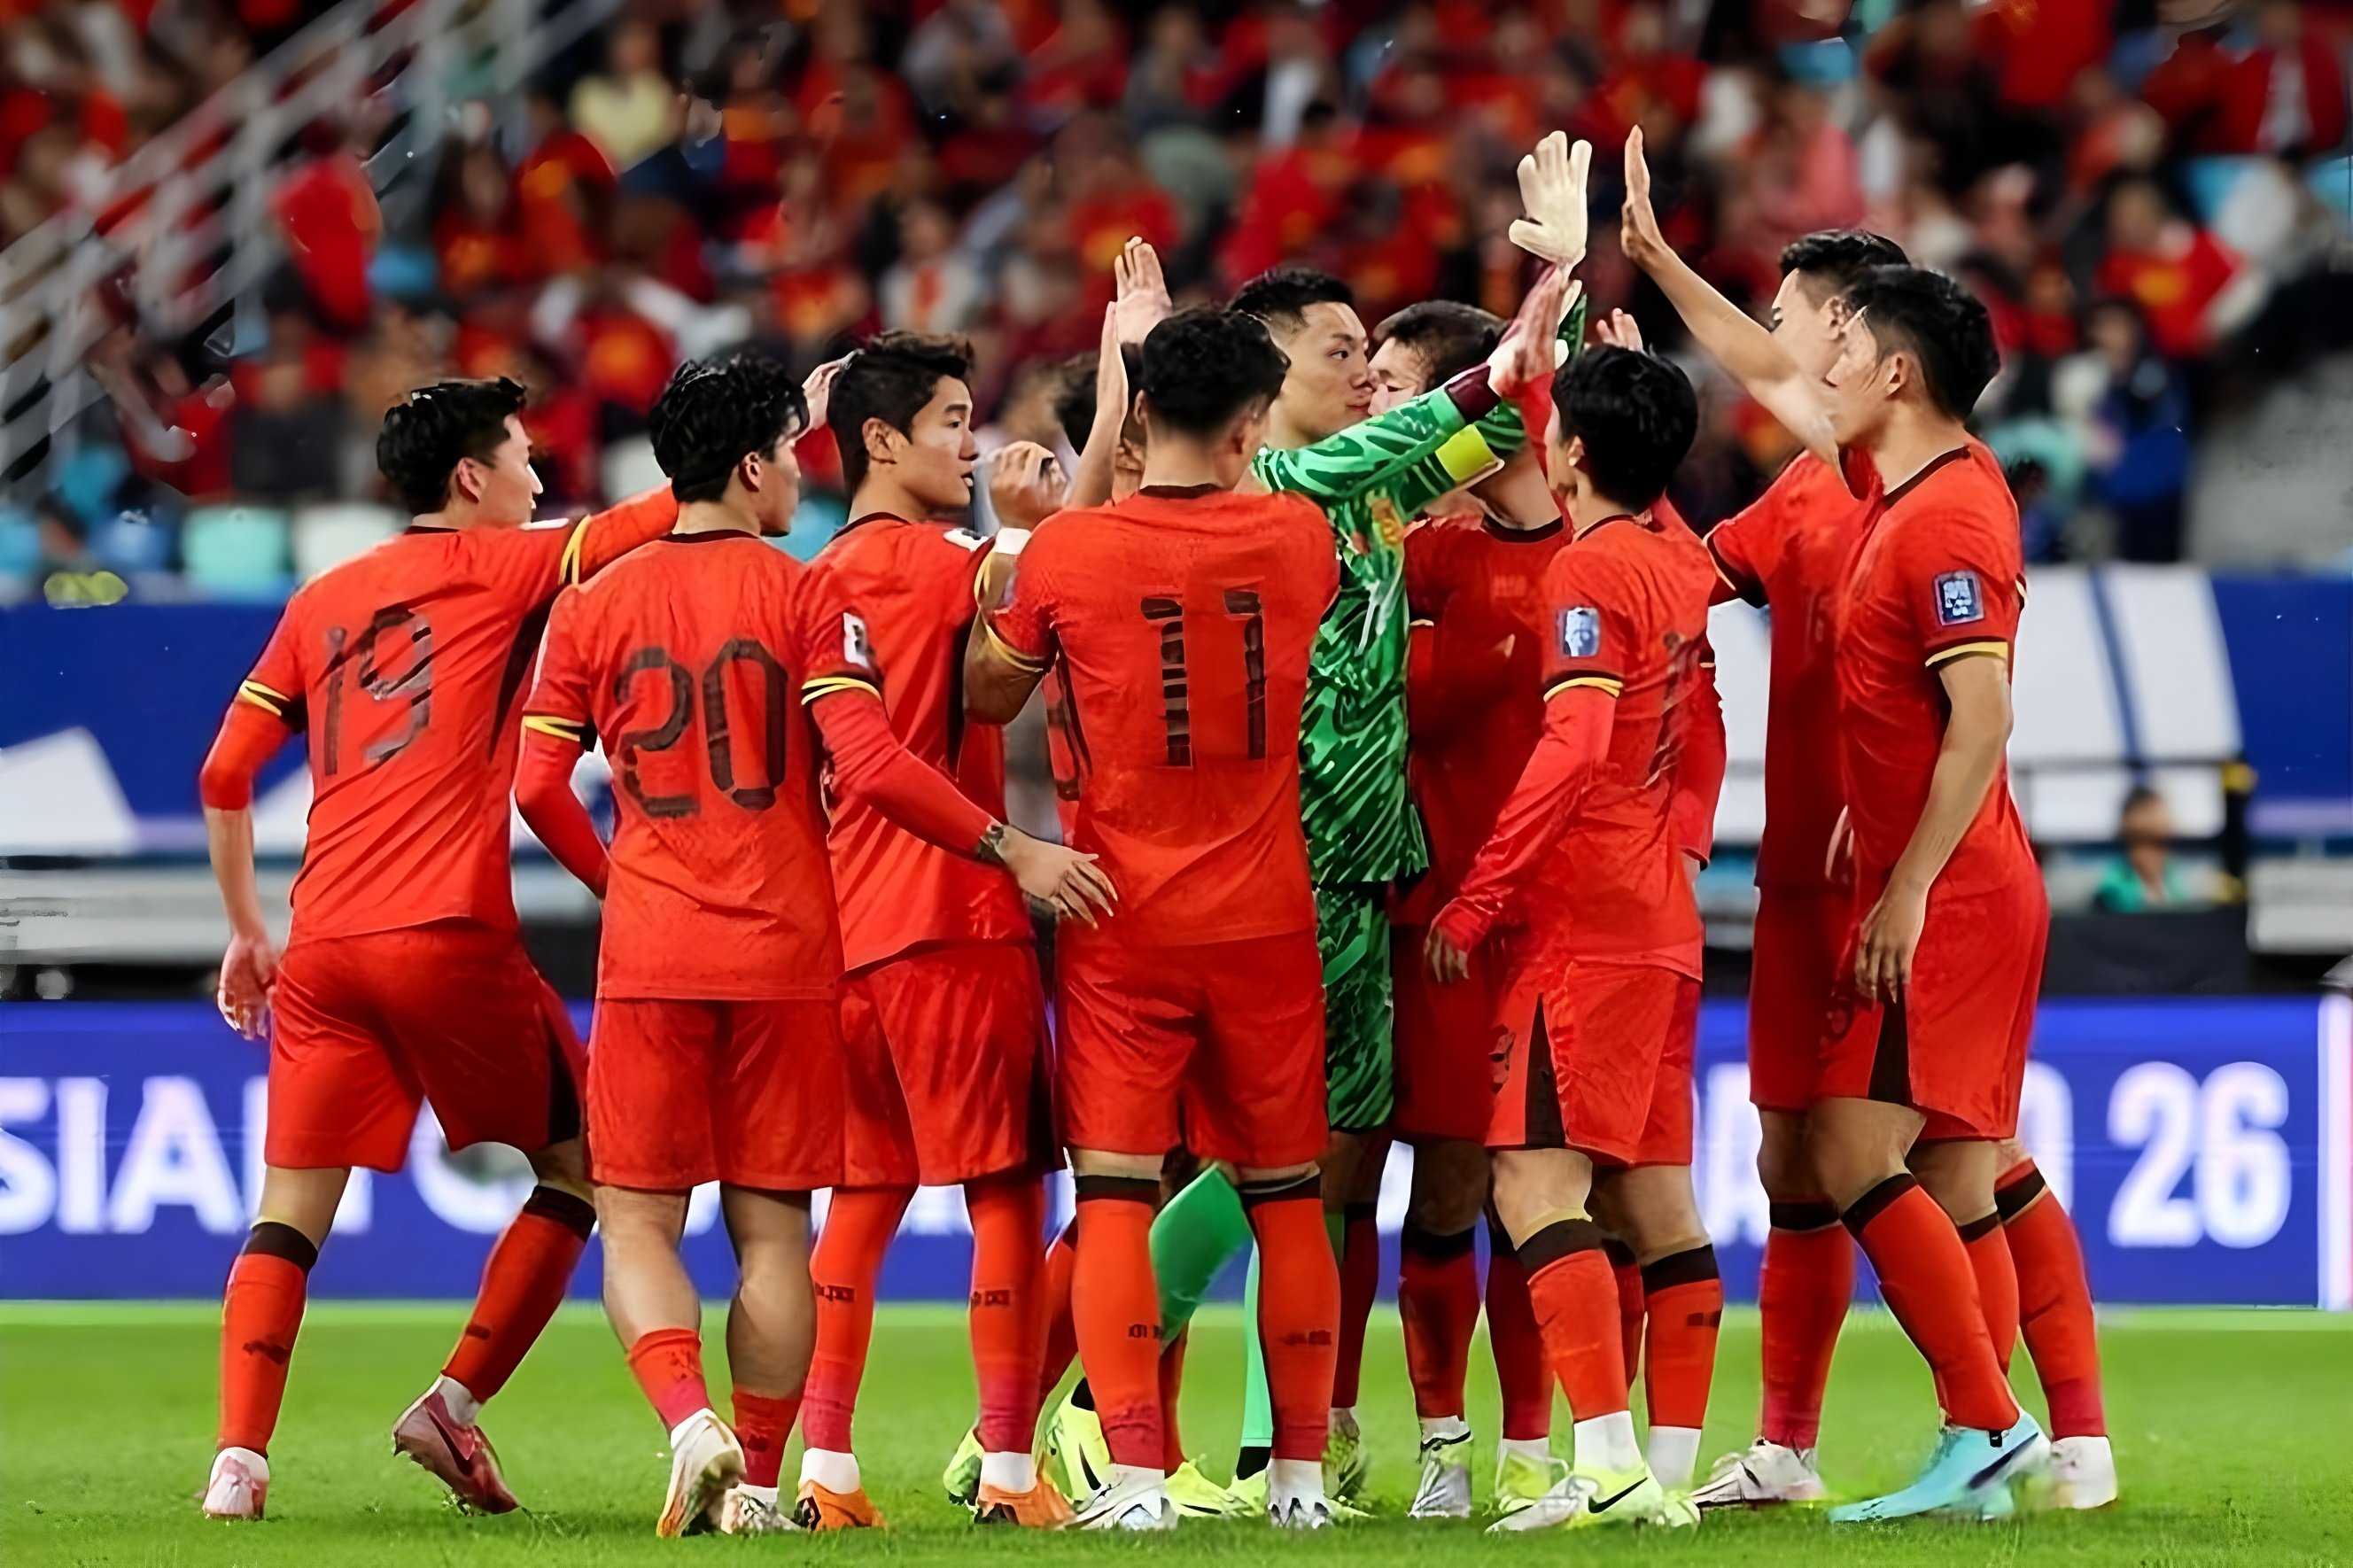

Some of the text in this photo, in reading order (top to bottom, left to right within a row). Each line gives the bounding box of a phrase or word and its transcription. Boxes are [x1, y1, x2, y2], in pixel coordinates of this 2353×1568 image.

[322, 605, 433, 776] 19
[613, 638, 788, 817] 20
[1140, 591, 1268, 768] 11
[0, 1075, 374, 1235] SIA
[2107, 1060, 2292, 1247] 26
